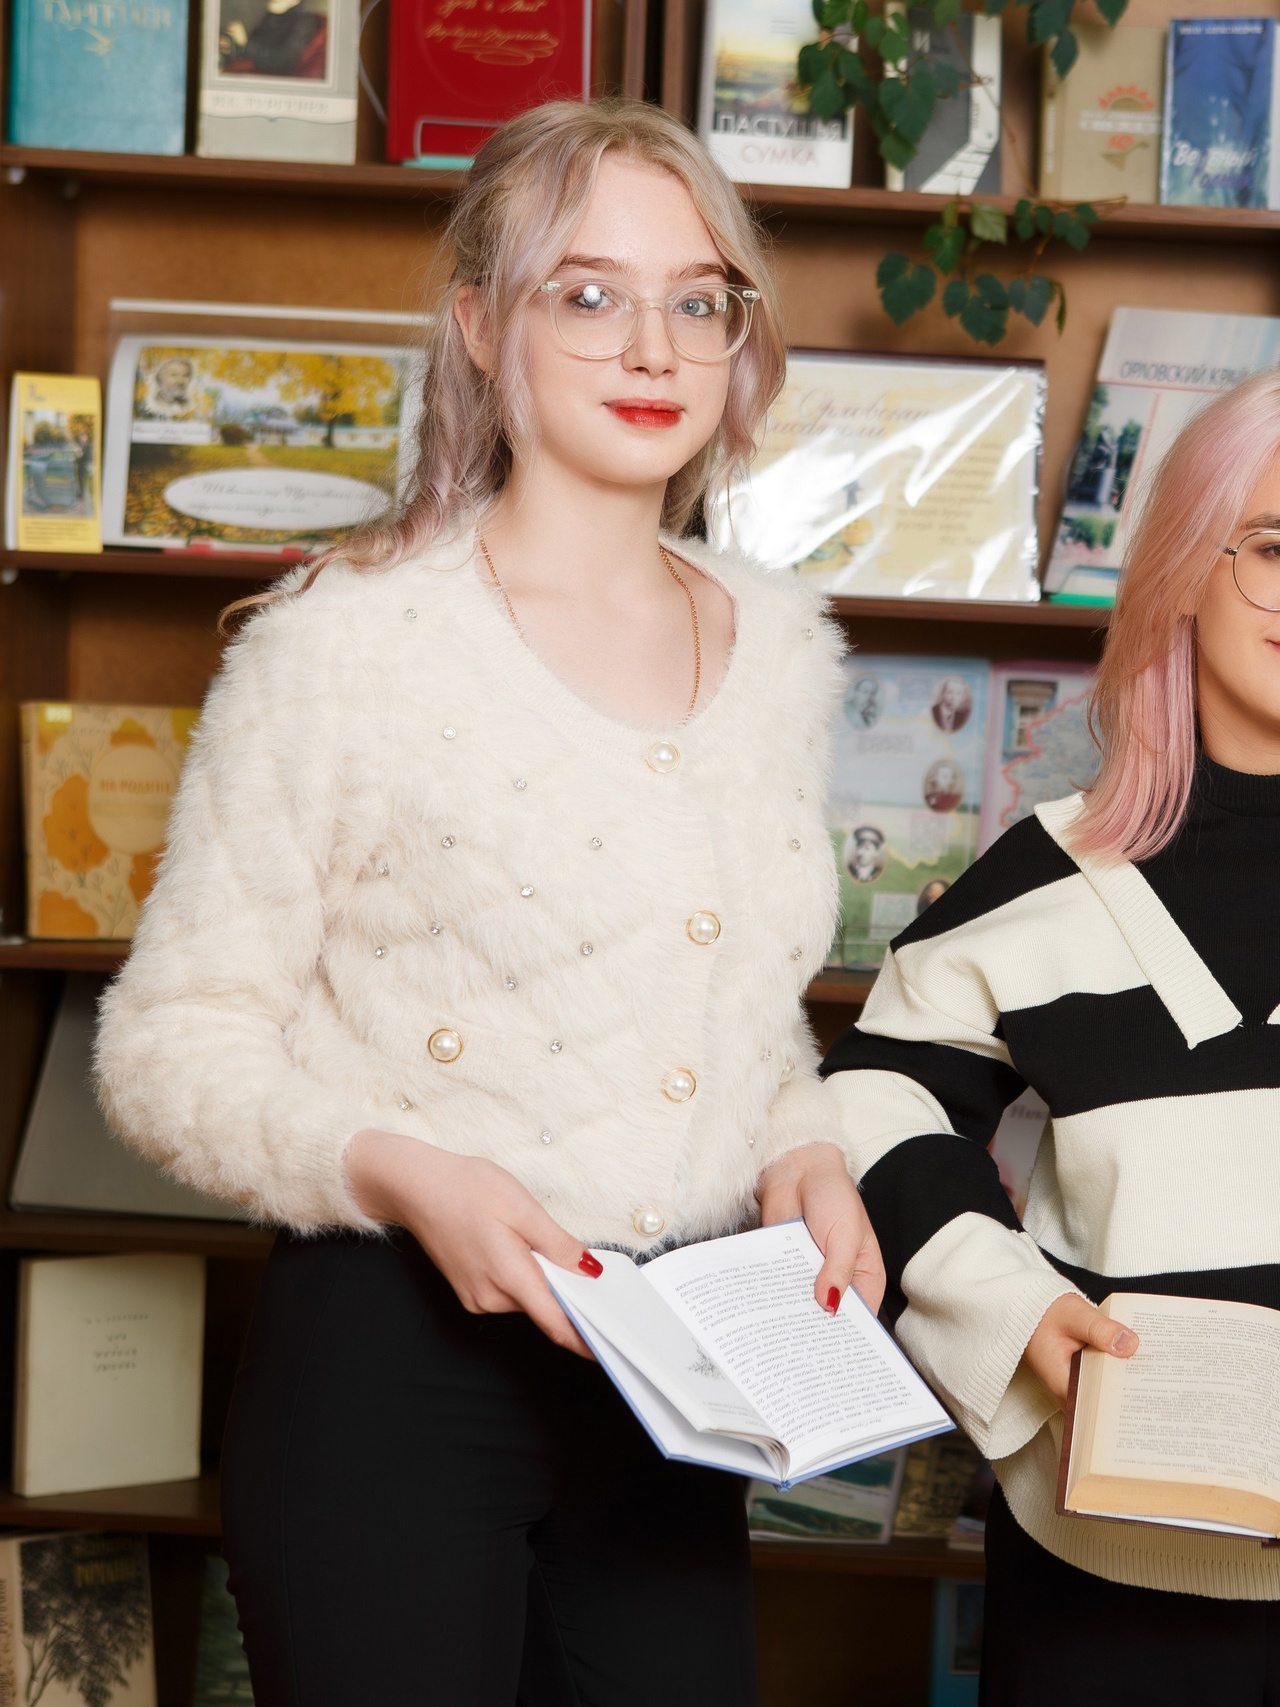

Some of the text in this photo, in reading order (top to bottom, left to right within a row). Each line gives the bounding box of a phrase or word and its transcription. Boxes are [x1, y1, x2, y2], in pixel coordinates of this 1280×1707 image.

[716, 115, 842, 142] ПАСТУШЬЯ
[740, 144, 818, 166] СУМКА
[1119, 361, 1203, 385] ОРЛОВСКИЙ
